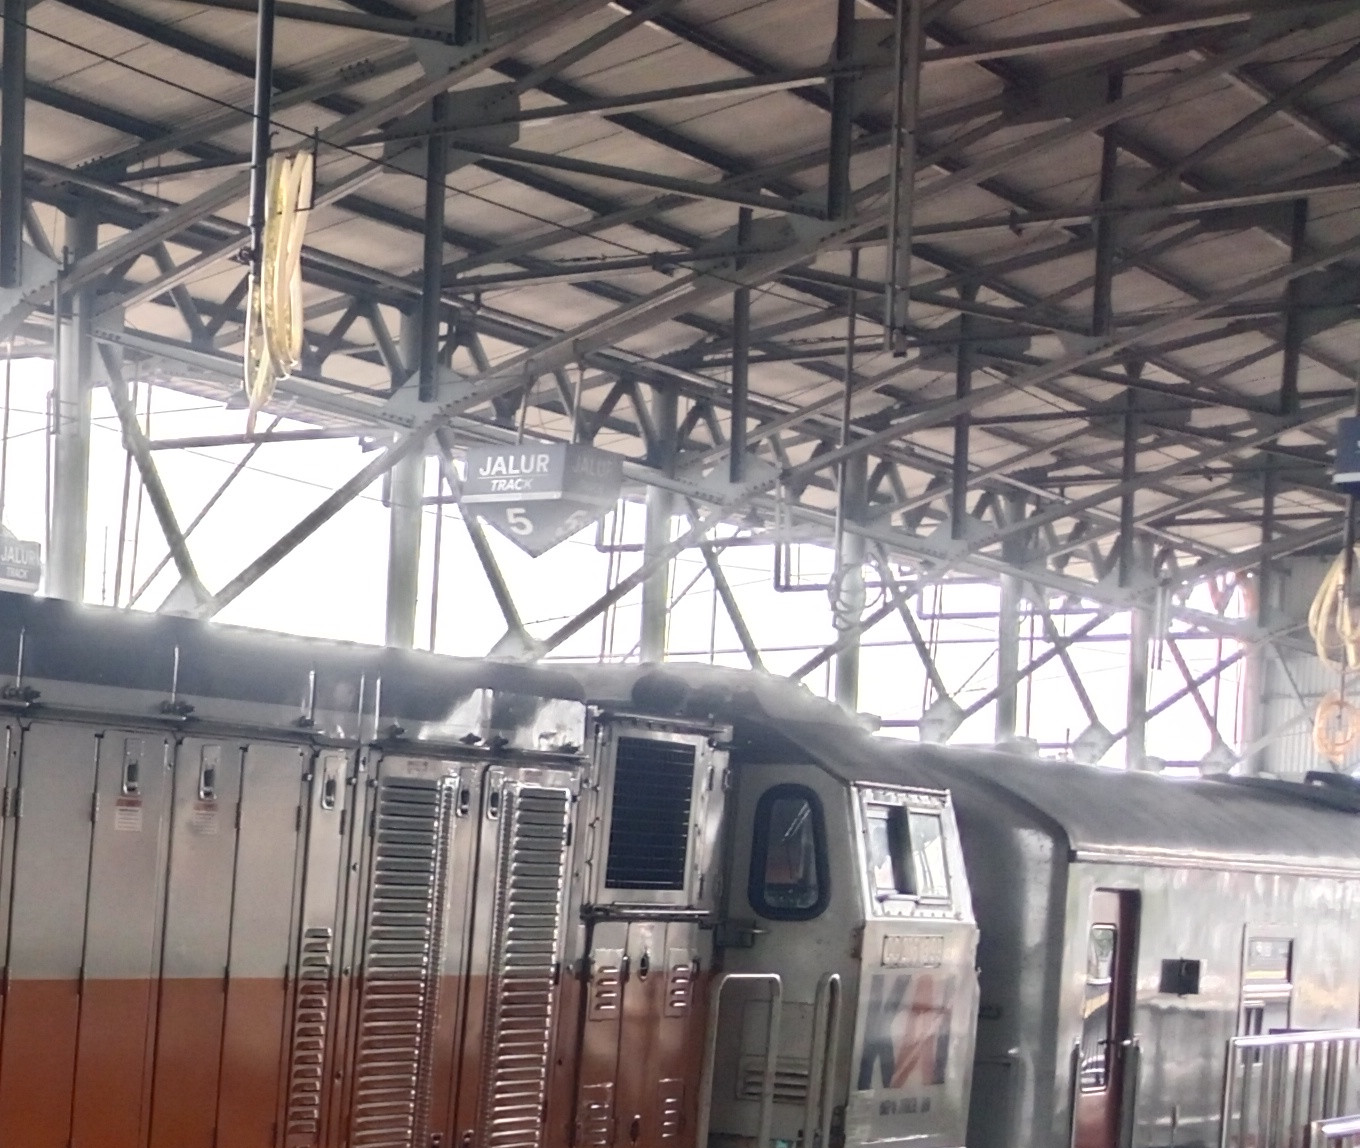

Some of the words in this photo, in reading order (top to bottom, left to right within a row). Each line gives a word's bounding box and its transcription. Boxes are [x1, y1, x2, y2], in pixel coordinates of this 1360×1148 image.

[479, 454, 549, 476] JALUR
[490, 478, 533, 491] TRACK
[506, 507, 534, 536] 5
[857, 974, 956, 1091] KAI
